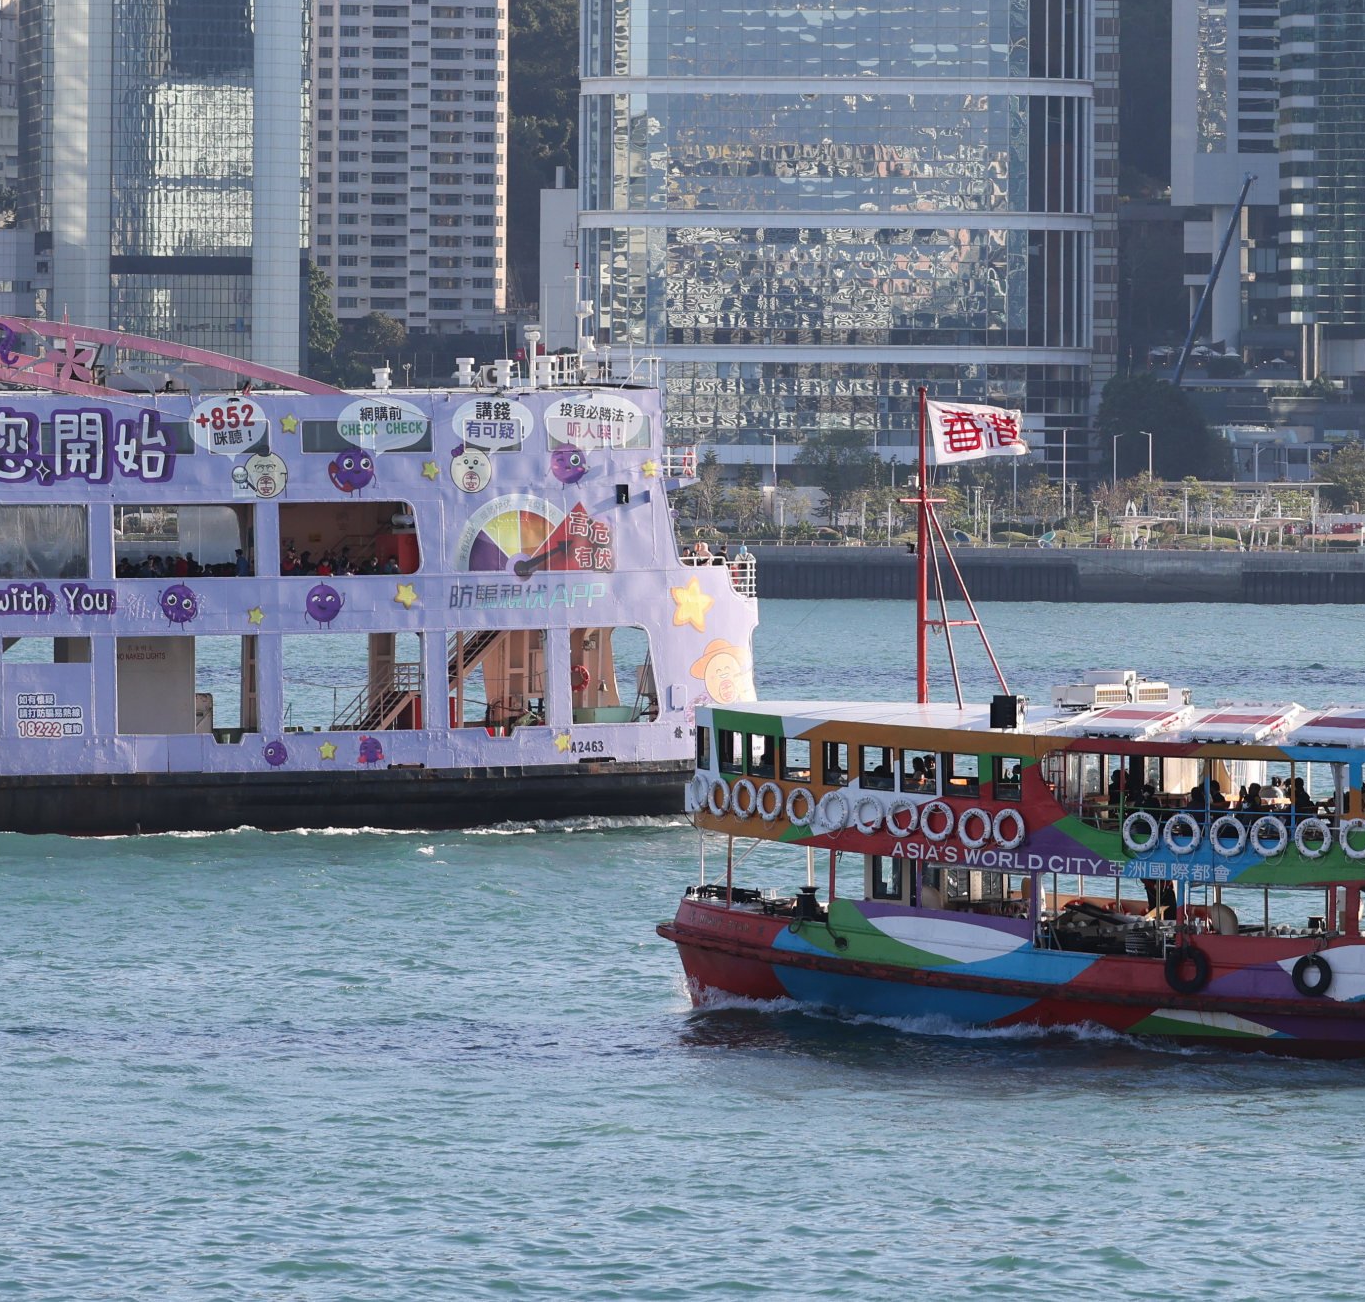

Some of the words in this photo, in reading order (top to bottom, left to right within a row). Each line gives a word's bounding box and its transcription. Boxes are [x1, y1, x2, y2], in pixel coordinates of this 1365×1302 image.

[196, 404, 255, 430] +852
[360, 406, 403, 421] 網購前
[475, 402, 511, 420] 講錢
[341, 423, 378, 436] CHECK
[386, 421, 423, 435] CHECK
[569, 512, 609, 544] 高危
[575, 548, 612, 569] 有伏
[63, 587, 108, 612] You
[19, 721, 62, 737] 18222
[570, 740, 604, 753] A2463
[891, 842, 958, 863] ASIA'S
[963, 849, 1043, 870] WORLD
[1048, 855, 1103, 875] CITY
[1107, 860, 1232, 882] 亞洲國際都會
